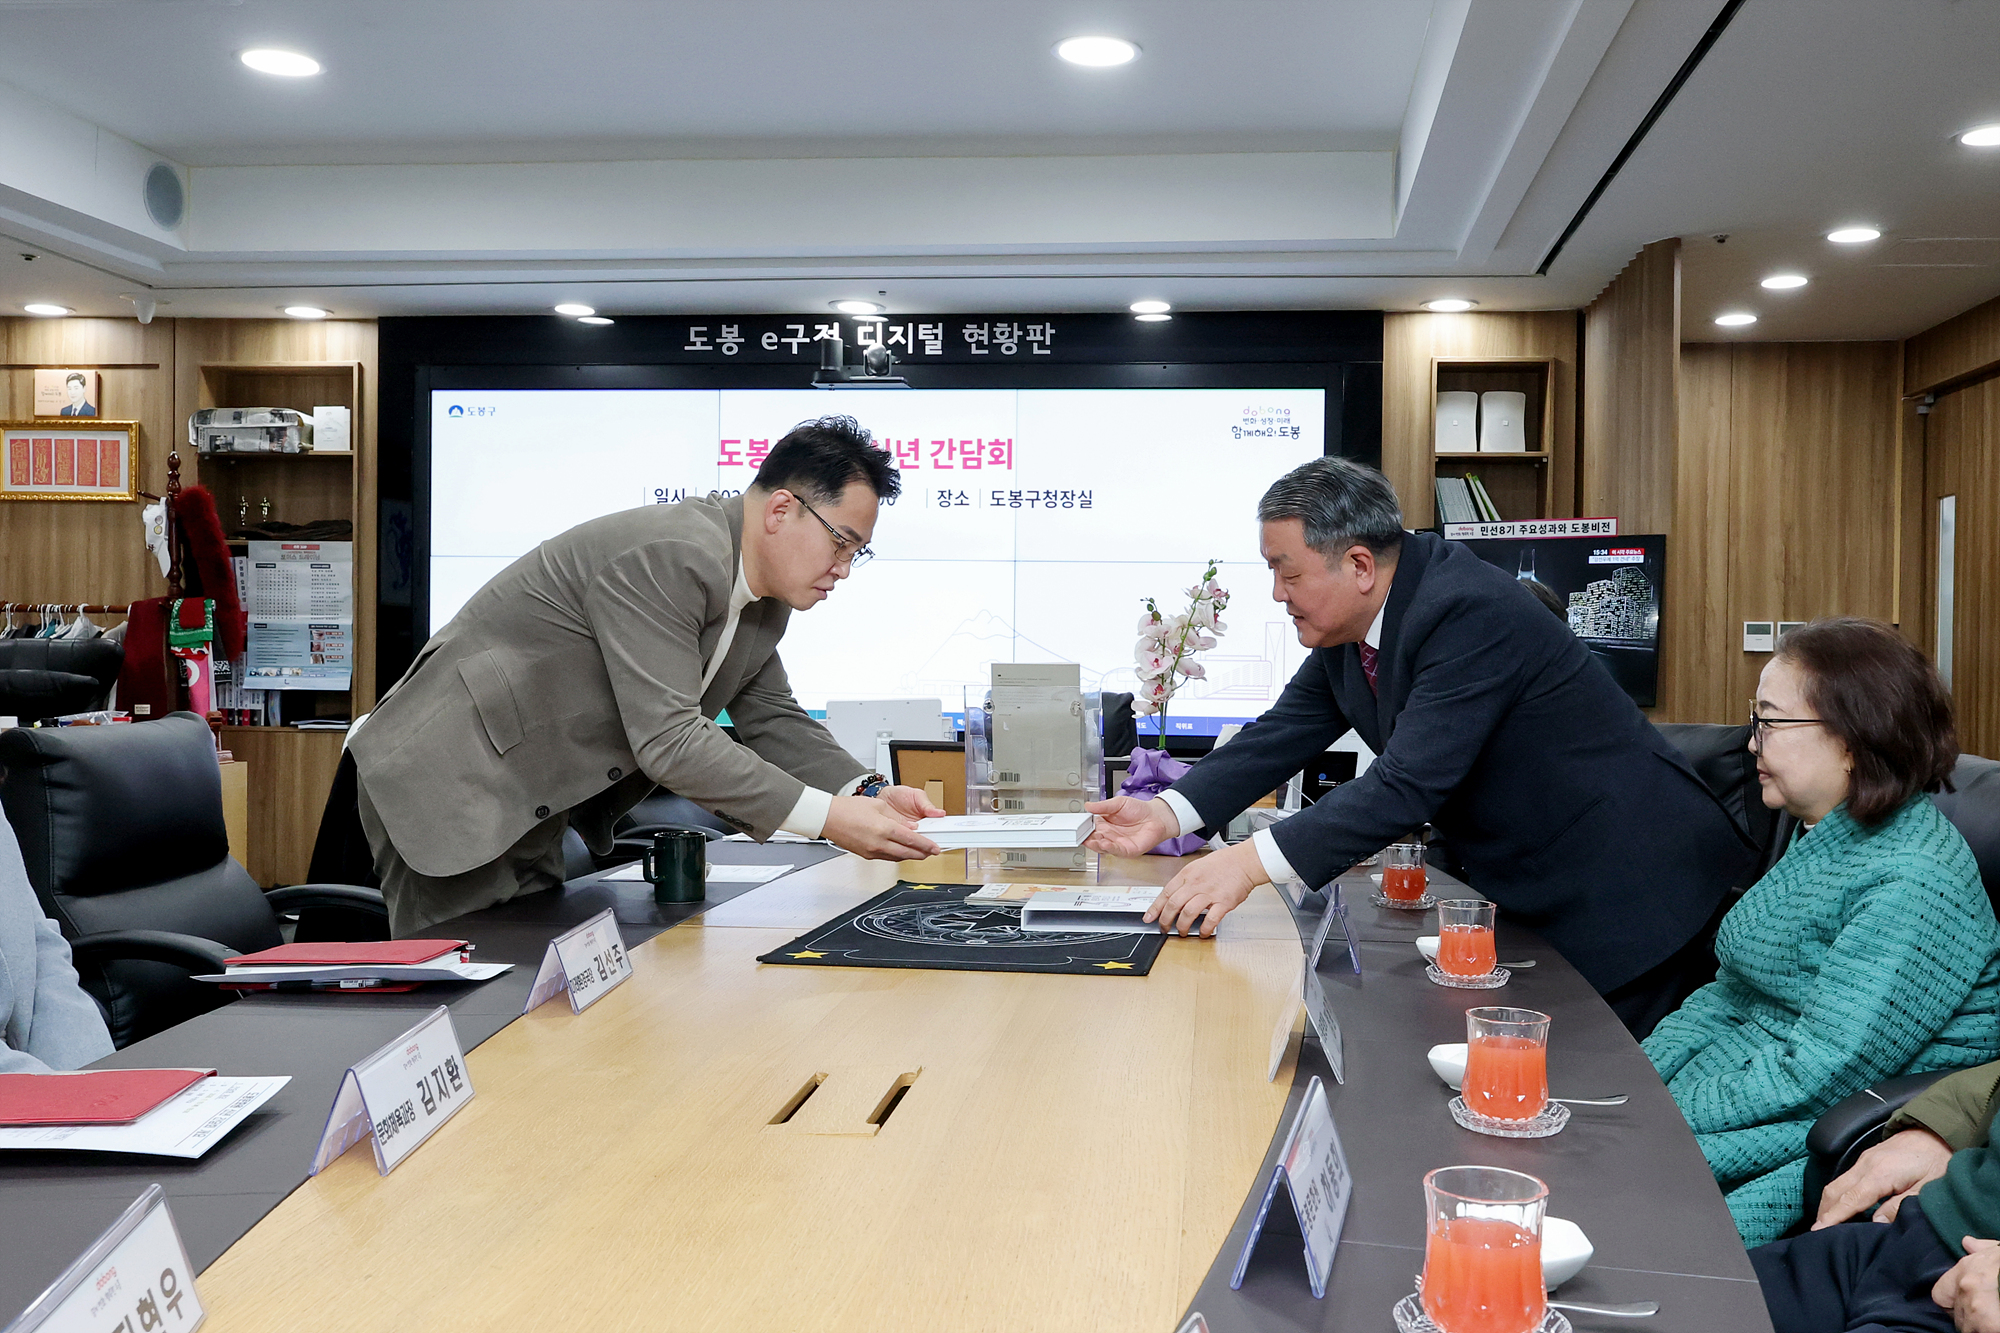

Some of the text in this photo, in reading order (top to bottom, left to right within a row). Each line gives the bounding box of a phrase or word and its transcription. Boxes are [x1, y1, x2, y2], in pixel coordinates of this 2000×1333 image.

[684, 324, 745, 356] 도봉
[857, 322, 943, 355] 디지털
[962, 322, 1056, 355] 현황판
[467, 406, 496, 417] 도봉구
[930, 438, 1013, 470] 간담회
[654, 488, 685, 505] 일시
[937, 489, 1093, 509] 장소 도봉구청장실
[1480, 521, 1612, 537] 민선8기 주요성과와 도봉비전
[594, 943, 624, 982] 김선주
[376, 1054, 464, 1146] 문화체육과장 김지환
